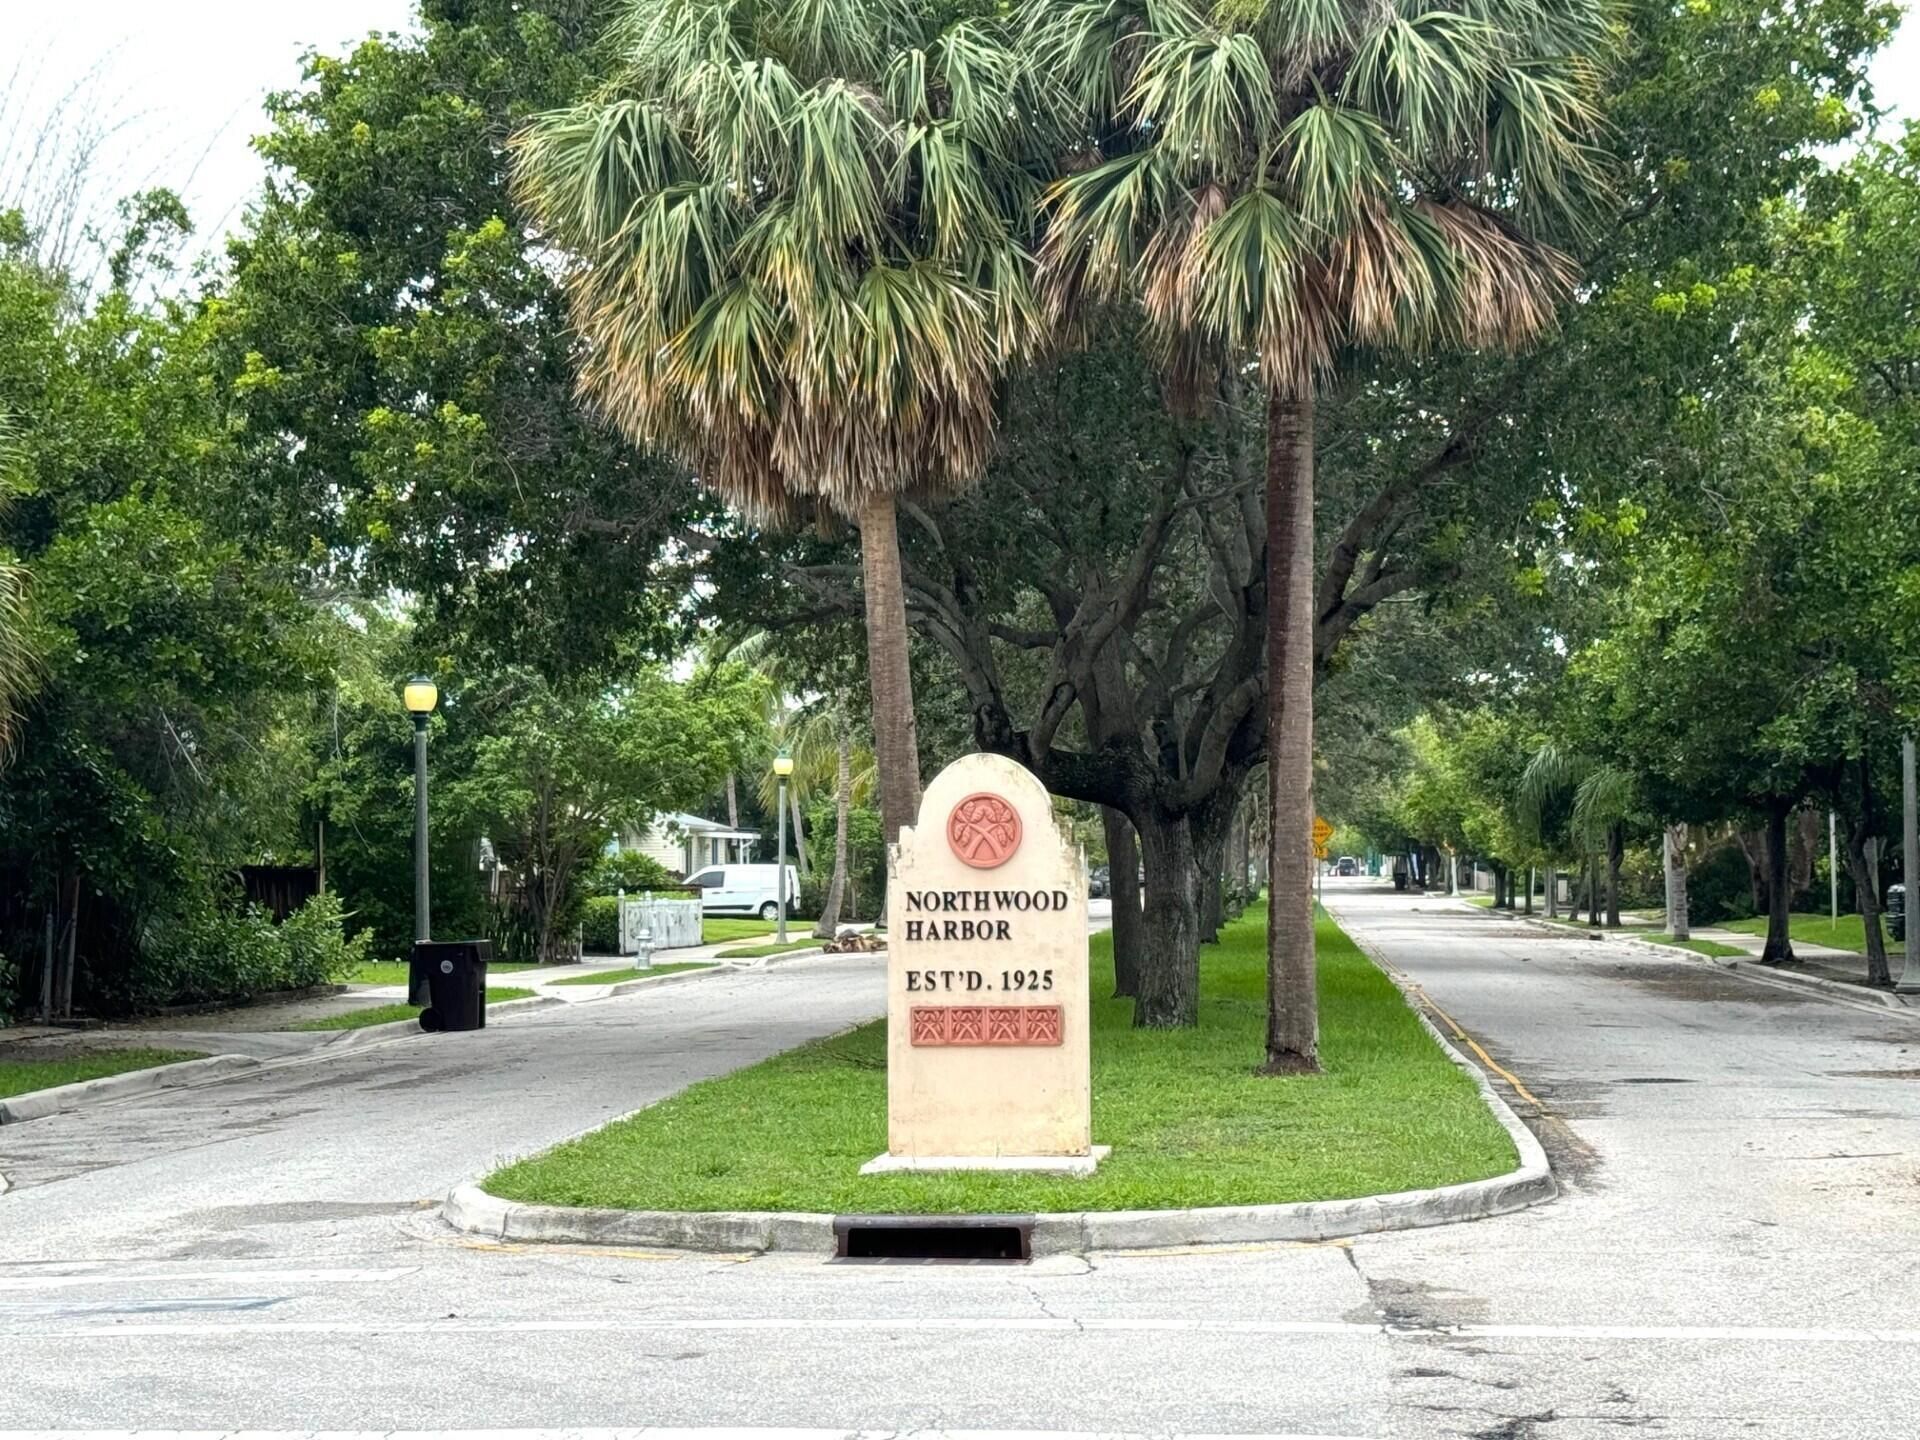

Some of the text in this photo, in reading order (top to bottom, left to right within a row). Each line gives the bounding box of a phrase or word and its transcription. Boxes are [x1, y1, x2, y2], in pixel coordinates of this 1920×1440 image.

[906, 890, 1068, 912] NORTHWOOD
[906, 919, 1011, 941] HARBOR
[1002, 969, 1053, 991] 1925
